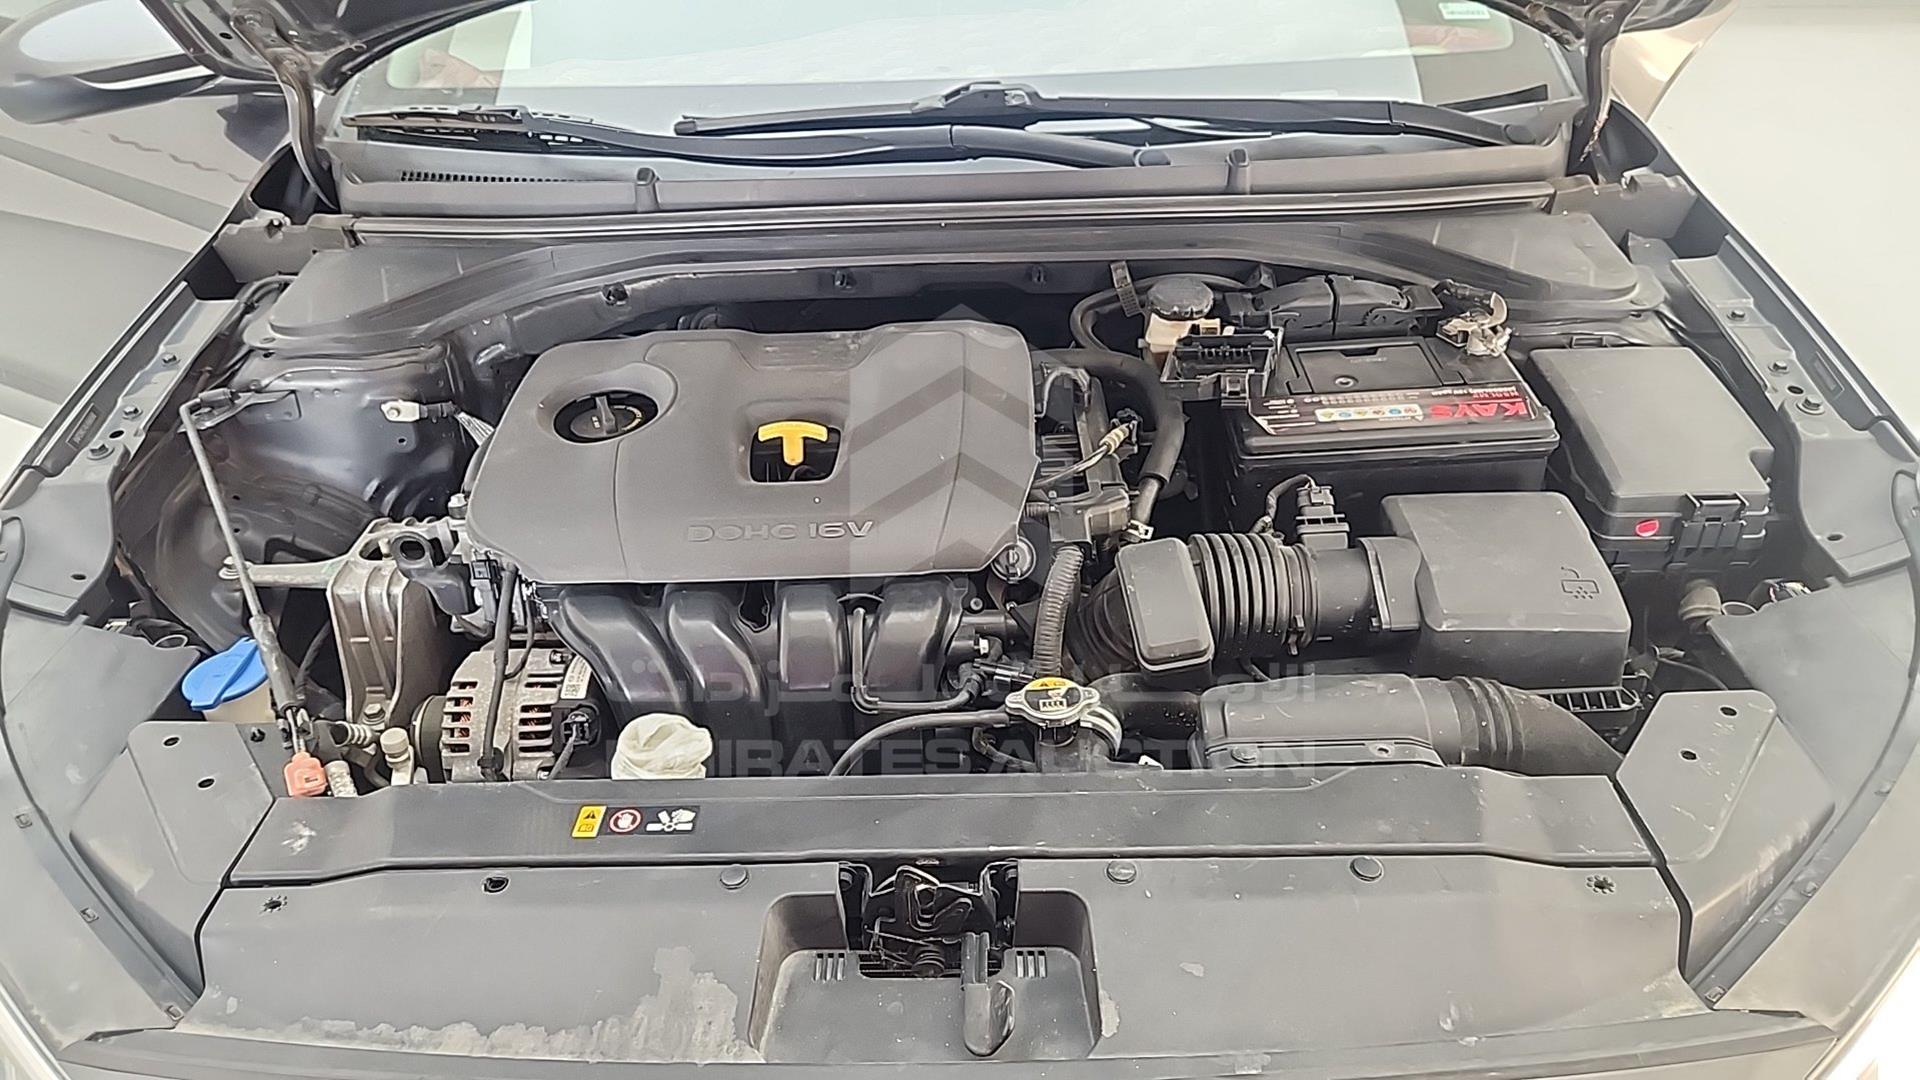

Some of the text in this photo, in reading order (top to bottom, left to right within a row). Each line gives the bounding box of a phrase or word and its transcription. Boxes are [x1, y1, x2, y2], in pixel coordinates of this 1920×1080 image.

[1429, 401, 1528, 419] KAYS
[688, 520, 874, 542] DOHC 16V
